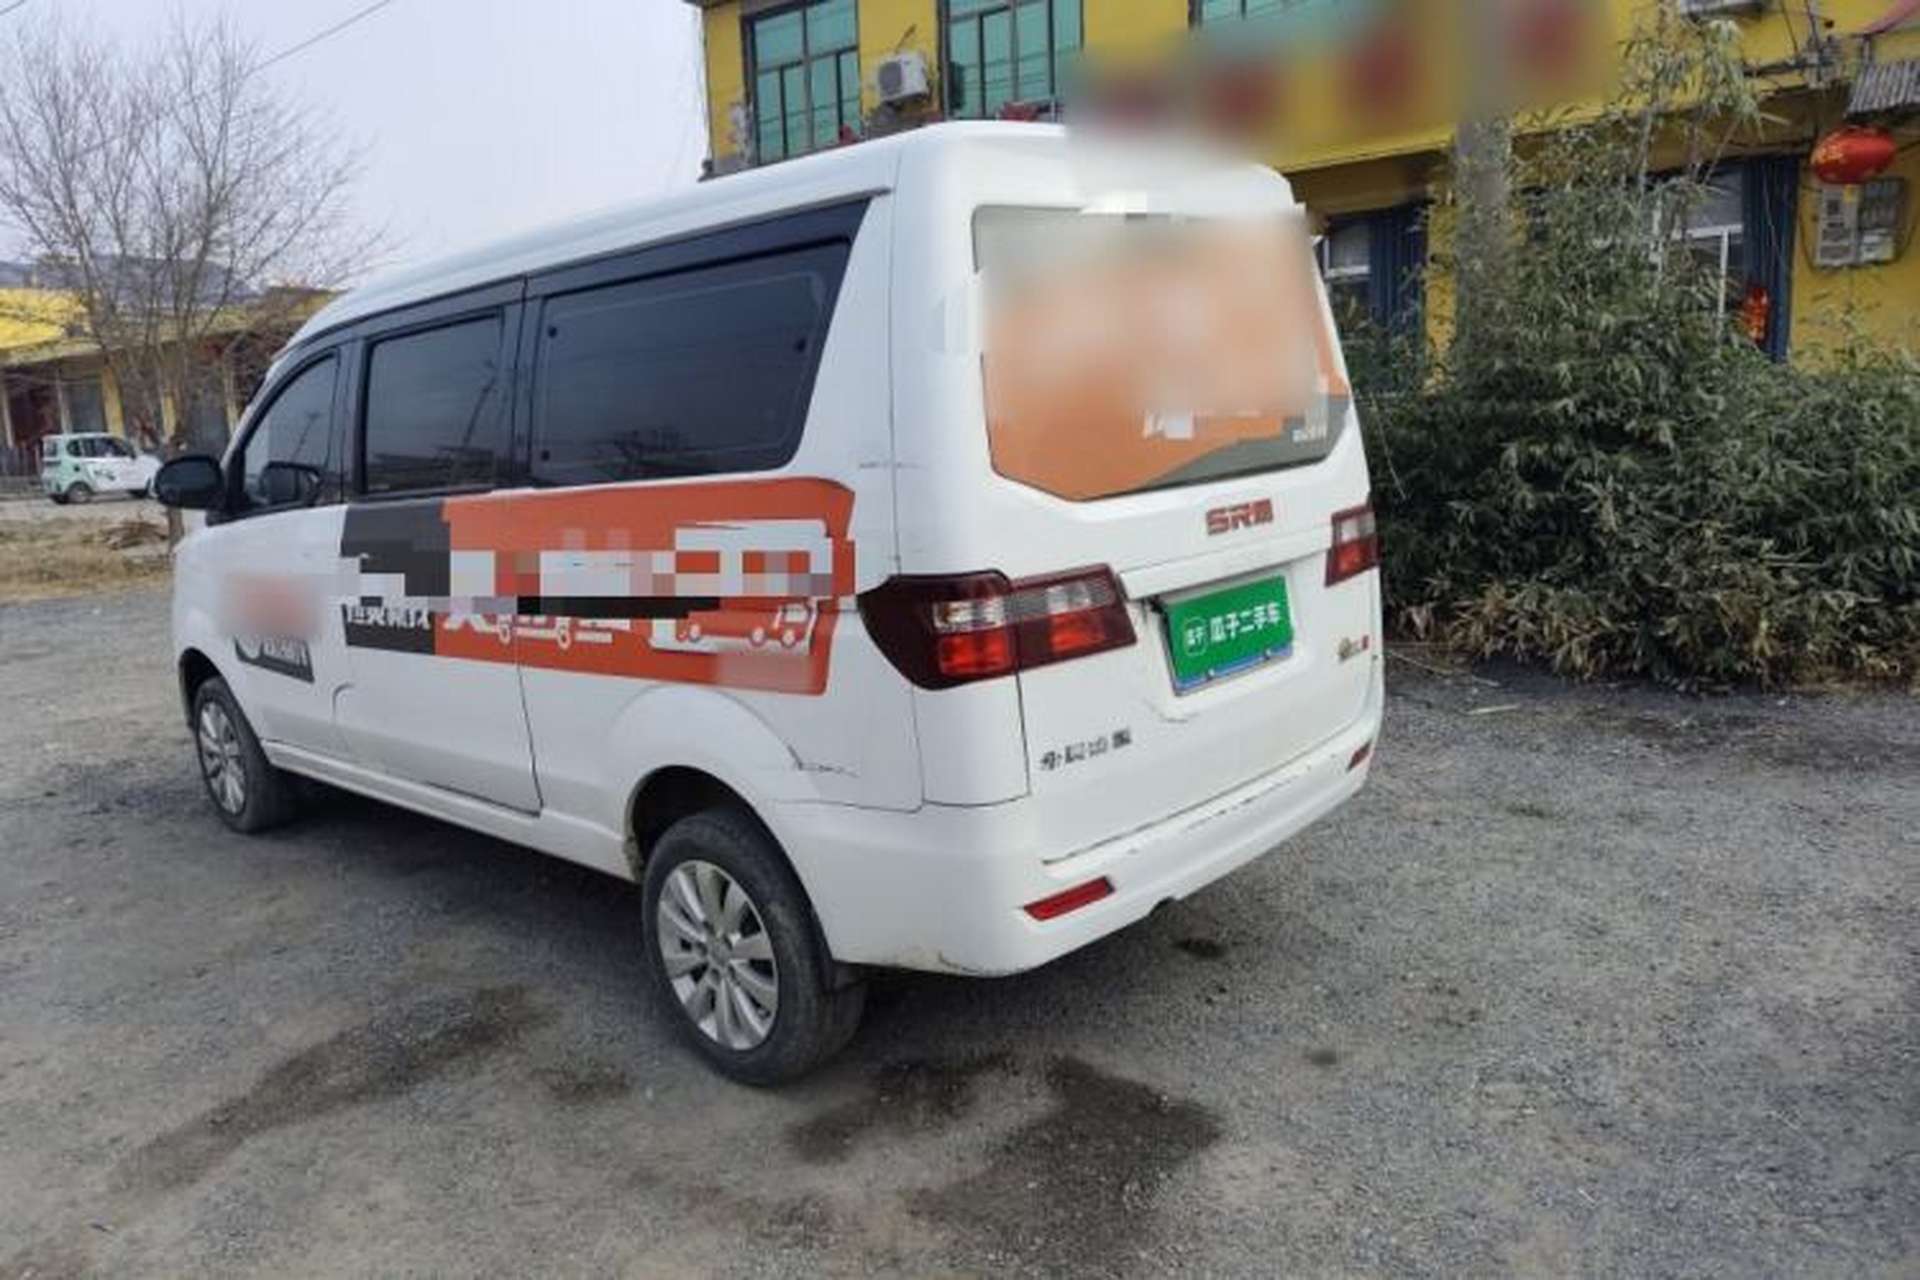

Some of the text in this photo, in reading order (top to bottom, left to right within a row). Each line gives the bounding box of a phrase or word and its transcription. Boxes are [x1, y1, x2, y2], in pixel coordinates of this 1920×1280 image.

[1210, 602, 1281, 642] 瓜子二手车
